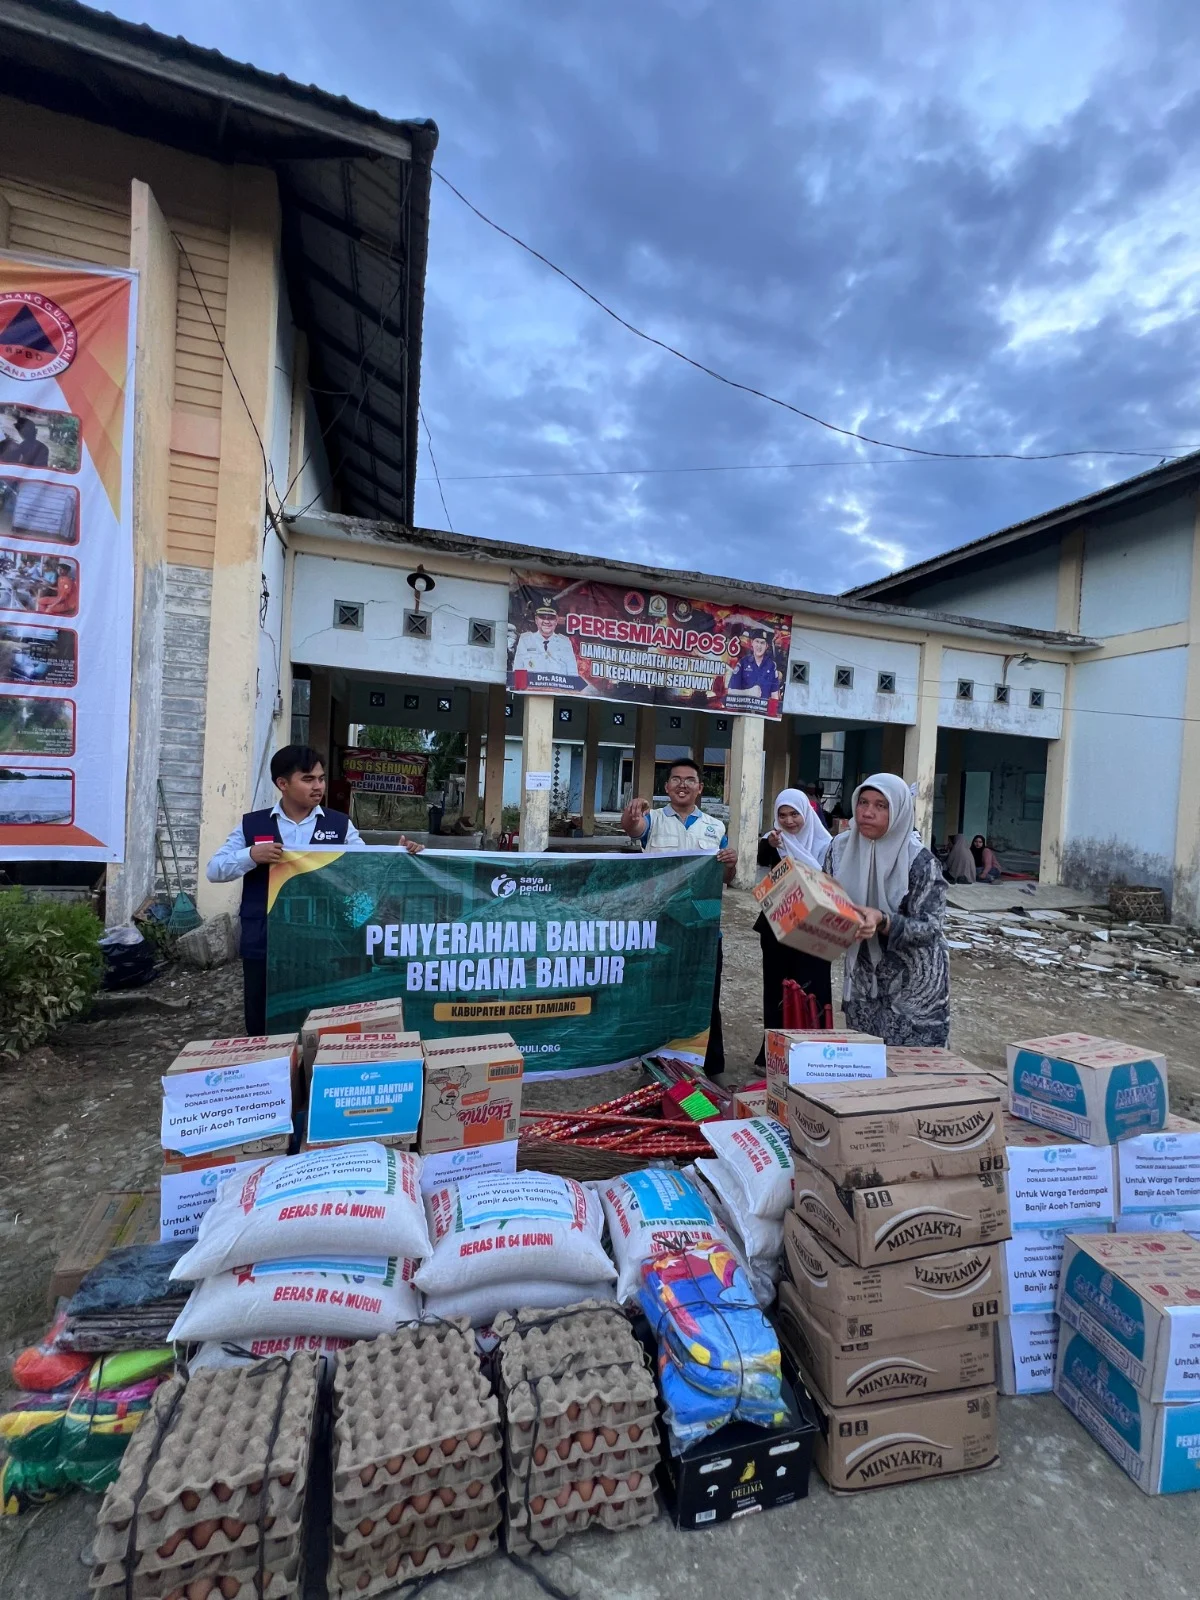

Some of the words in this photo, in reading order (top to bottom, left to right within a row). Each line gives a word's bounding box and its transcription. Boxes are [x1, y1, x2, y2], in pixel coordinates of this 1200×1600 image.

[566, 613, 685, 650] PERESMIAN
[684, 629, 726, 655] POS
[727, 636, 741, 657] 6
[580, 643, 618, 662] DAMKAR
[618, 647, 666, 669] KABUPATEN
[666, 655, 689, 671] ACEH
[689, 659, 726, 675] TAMIANG
[551, 675, 567, 683] ASRA
[592, 661, 605, 678] DI
[605, 663, 666, 687] KECAMATAN
[666, 671, 714, 691] SERUWAY
[365, 761, 372, 771] 6
[375, 761, 424, 775] SERUWAY
[351, 780, 374, 790] ACEH
[375, 782, 414, 792] TAMIANG
[364, 773, 402, 783] DAMKAR
[519, 877, 544, 885] saya
[519, 883, 552, 895] peduli
[366, 921, 537, 957] PENYERAHAN
[546, 920, 657, 952] BANTUAN
[406, 957, 526, 991] BENCANA
[536, 955, 625, 988] BANJIR
[451, 1005, 506, 1017] KABUPATEN
[508, 1004, 532, 1016] ACEH
[535, 1001, 576, 1014] TAMIANG
[185, 1089, 219, 1098] Penyaluran
[220, 1085, 245, 1094] Program
[245, 1081, 270, 1090] Bantuan
[323, 1086, 376, 1098] PENYERAHAN
[378, 1082, 414, 1094] BANTUAN
[184, 1099, 209, 1108] DONASI
[224, 1093, 252, 1101] SAHABAT
[335, 1096, 373, 1108] BENCANA
[374, 1094, 403, 1105] BANJIR
[169, 1114, 198, 1126] Untuk
[200, 1107, 233, 1120] Warga
[235, 1098, 286, 1113] Terdampak
[180, 1126, 208, 1138] Banjir
[210, 1121, 235, 1131] Aceh
[237, 1111, 277, 1126] Tamiang
[917, 1110, 986, 1137] MINYAKITA
[749, 1119, 767, 1135] MUTU
[764, 1133, 791, 1169] TERJAMIN
[296, 1165, 329, 1175] Warga
[331, 1159, 382, 1168] Terdampak
[275, 1178, 303, 1190] Banjir
[305, 1172, 330, 1181] Aceh
[332, 1166, 372, 1175] Tamiang
[466, 1191, 490, 1201] Untuk
[492, 1188, 520, 1197] Warga
[1015, 1189, 1038, 1198] Untuk
[1040, 1190, 1066, 1198] Warga
[1067, 1186, 1108, 1197] Terdampak
[1134, 1189, 1154, 1197] Banjir
[1176, 1188, 1200, 1196] Tamian
[177, 1201, 202, 1210] DONASI
[278, 1204, 318, 1221] BERAS
[320, 1203, 333, 1216] IR
[334, 1203, 348, 1216] 64
[349, 1204, 386, 1219] MURNI
[1025, 1203, 1047, 1212] Banjir
[1048, 1202, 1068, 1210] Aceh
[1069, 1200, 1101, 1209] Tamiang
[162, 1215, 190, 1226] Untuk
[701, 1231, 712, 1240] KG
[886, 1221, 962, 1252] MINYAKITA
[459, 1240, 493, 1257] BERAS
[495, 1237, 506, 1248] IR
[508, 1235, 520, 1247] 64
[522, 1233, 553, 1246] MURNI
[914, 1255, 983, 1285] MINYAKITA
[1013, 1270, 1037, 1279] Untuk
[1038, 1269, 1060, 1279] Warg
[1024, 1284, 1047, 1292] Banjir
[273, 1286, 314, 1302] BERAS
[315, 1288, 329, 1303] IR
[329, 1290, 344, 1305] 64
[345, 1294, 383, 1314] MURNI
[251, 1337, 292, 1355] BERAS
[293, 1336, 306, 1351] IR
[308, 1335, 321, 1350] 64
[1020, 1354, 1045, 1364] Untuk
[1030, 1368, 1051, 1377] Banjir
[857, 1372, 928, 1398] MINYAKITA
[858, 1450, 943, 1482] MINYAKITA
[731, 1483, 764, 1499] DELIMA
